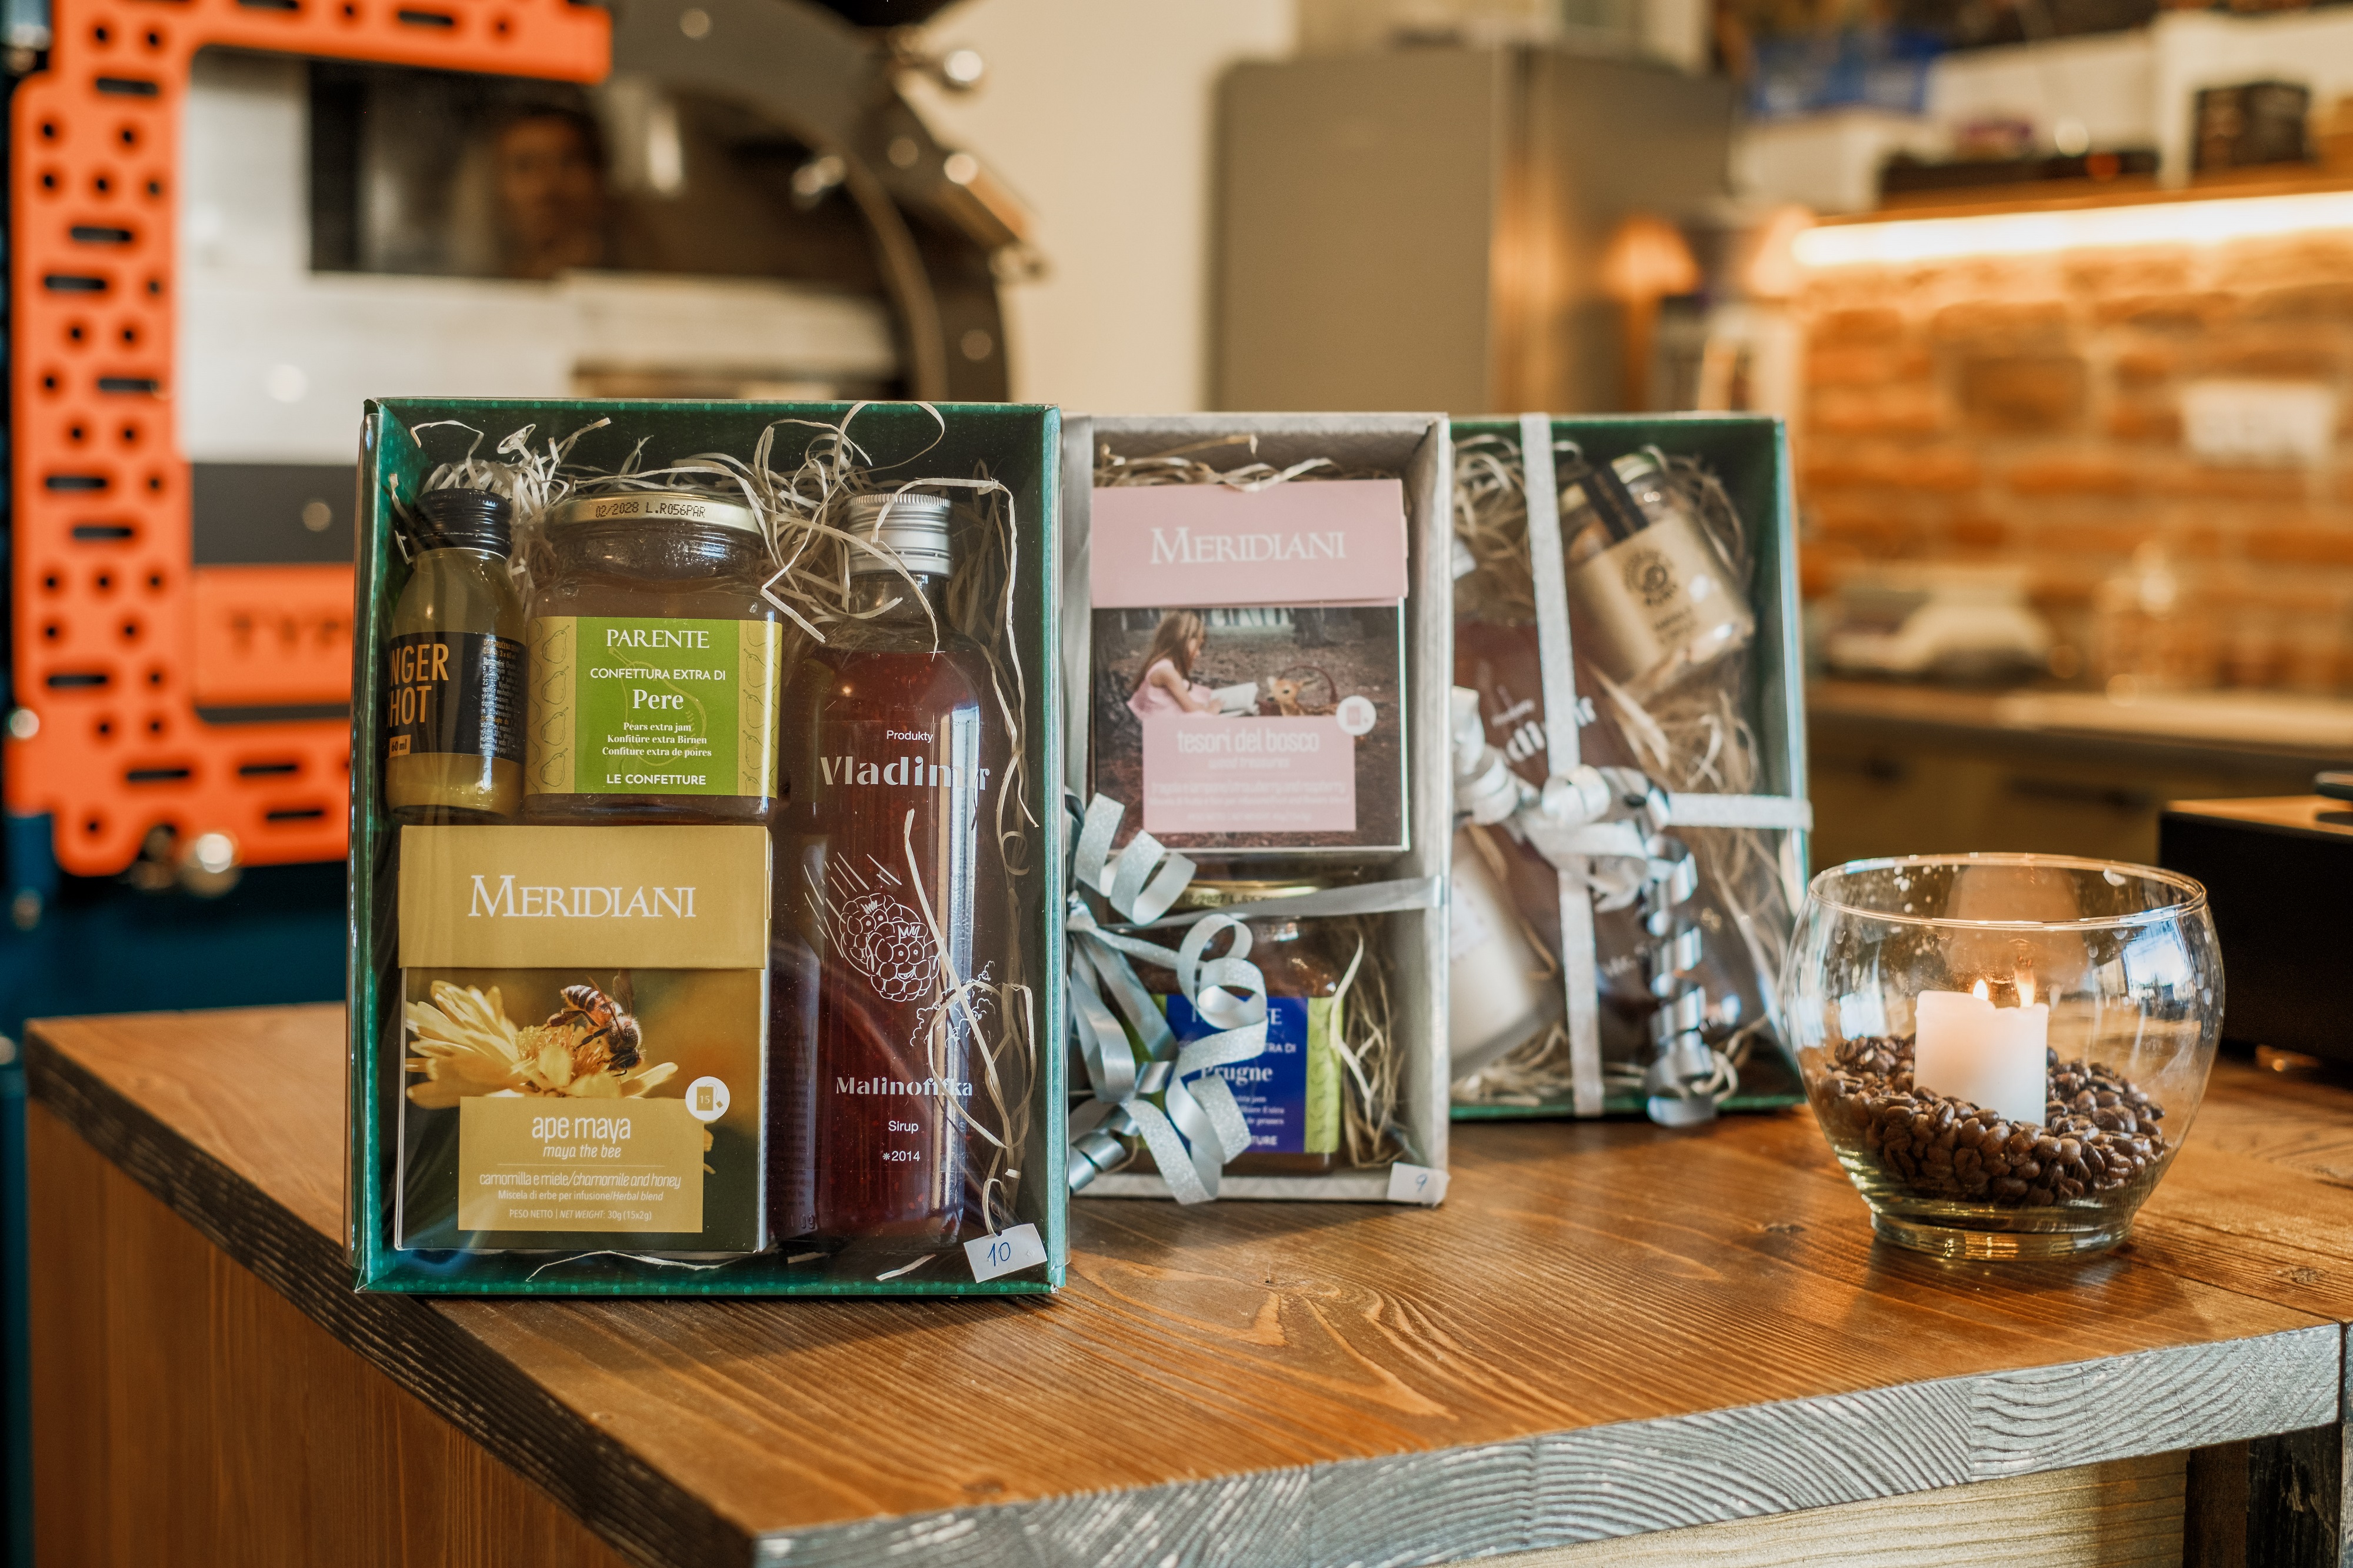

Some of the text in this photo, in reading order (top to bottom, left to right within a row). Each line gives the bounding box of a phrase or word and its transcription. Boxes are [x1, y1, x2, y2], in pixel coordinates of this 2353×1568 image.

[596, 502, 639, 518] 02/2028
[606, 629, 709, 649] PARENTE
[391, 643, 449, 686] NGER
[590, 668, 725, 680] CONFETTURA EXTRA DI
[632, 689, 684, 709] Pere
[389, 685, 432, 728] HOT
[624, 722, 648, 730] Pears
[674, 723, 691, 733] jam
[608, 735, 650, 743] Konfitüre
[678, 735, 707, 744] Birnen
[886, 730, 934, 743] Produkty
[391, 741, 399, 752] 60
[602, 746, 644, 755] Confiture
[684, 749, 712, 758] poires
[606, 774, 706, 785] LE CONFETTURE
[468, 875, 696, 918] MERIDIANI
[699, 1095, 710, 1104] 15
[532, 1116, 631, 1143] ape maya
[888, 1120, 919, 1134] Sirup
[543, 1144, 621, 1160] maya the bee
[891, 1150, 920, 1162] 2014
[479, 1172, 531, 1185] camomilla
[533, 1175, 539, 1185] e
[631, 1173, 651, 1186] and
[651, 1173, 681, 1189] honey
[498, 1190, 527, 1200] Miscela
[530, 1190, 537, 1200] di
[539, 1190, 556, 1200] erbe
[559, 1192, 572, 1202] per
[641, 1191, 664, 1201] blend
[509, 1209, 652, 1222] PESO NETTO NET WEIGHT: 30g (15x2g)
[987, 1242, 1011, 1267] 10
